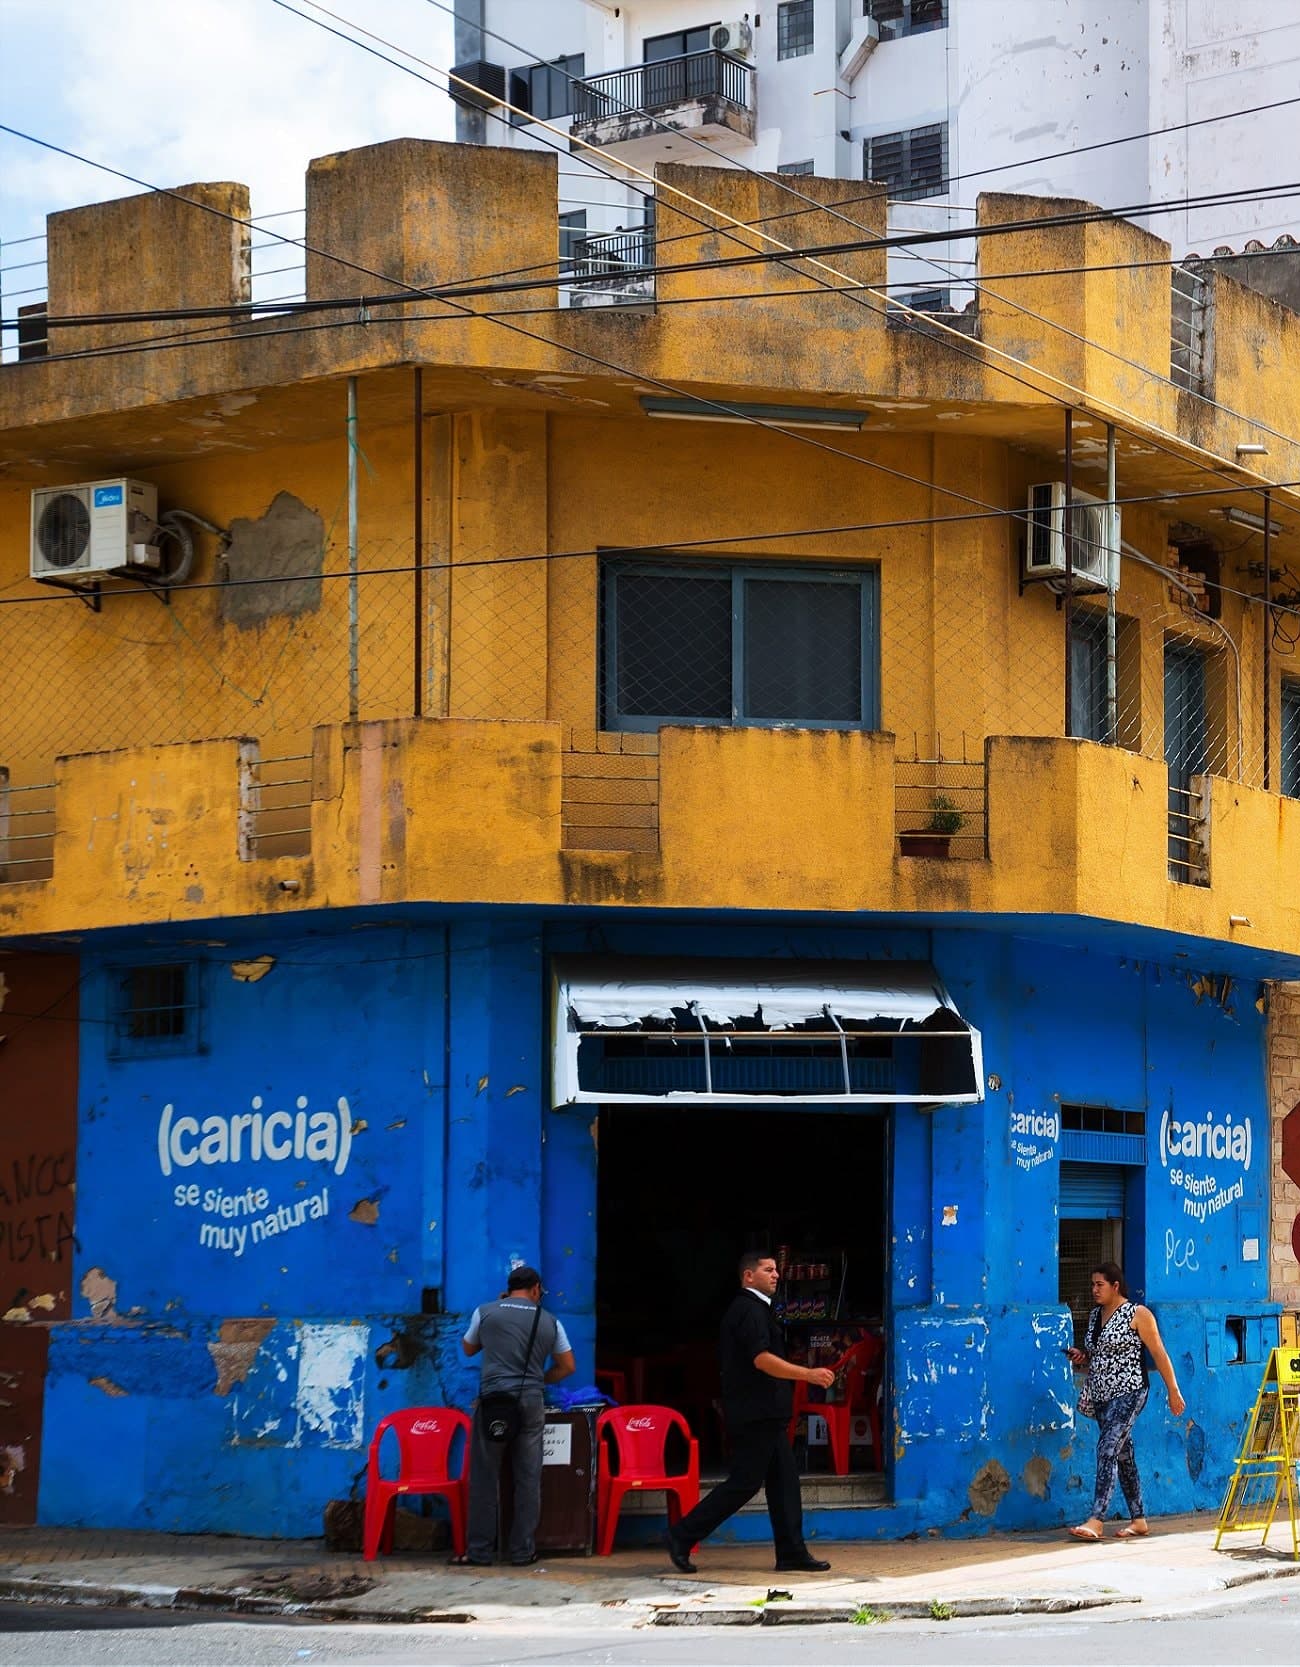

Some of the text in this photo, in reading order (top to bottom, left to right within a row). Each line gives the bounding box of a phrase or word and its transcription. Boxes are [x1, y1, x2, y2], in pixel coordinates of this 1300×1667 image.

[158, 1095, 352, 1176] (caricia)
[1160, 1110, 1252, 1171] (caricia)
[1016, 1156, 1031, 1172] muy
[1170, 1168, 1217, 1197] se siente
[174, 1183, 270, 1218] se siente
[199, 1186, 329, 1257] muy natural
[1183, 1177, 1244, 1224] muy natural
